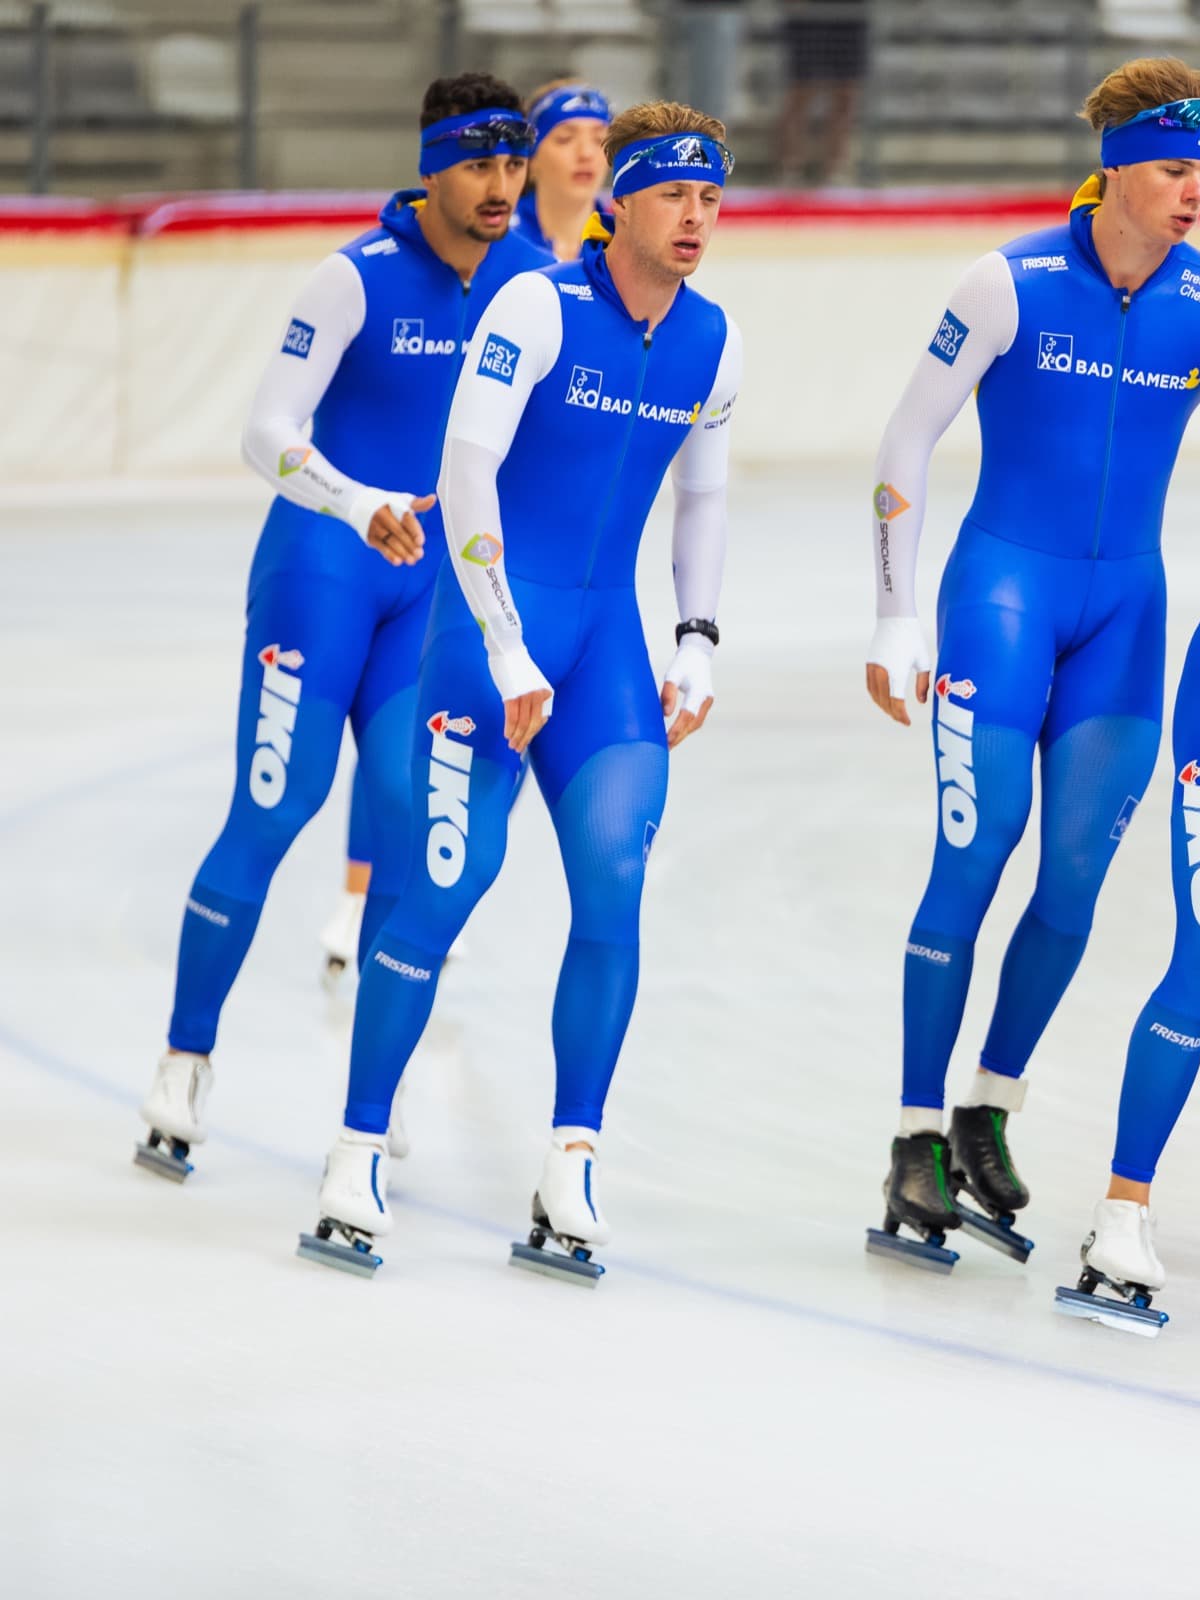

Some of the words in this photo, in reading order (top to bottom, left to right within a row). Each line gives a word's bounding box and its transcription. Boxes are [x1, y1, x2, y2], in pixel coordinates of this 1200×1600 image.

[1022, 255, 1066, 270] FRISTADS
[941, 318, 963, 344] PSY
[425, 340, 456, 355] BAD
[485, 341, 515, 364] PSY
[933, 333, 957, 356] NED
[481, 355, 512, 377] NED
[1076, 359, 1113, 378] BAD
[1122, 368, 1188, 390] KAMERS
[601, 396, 632, 414] BAD
[637, 401, 692, 425] KAMERS
[879, 521, 893, 593] SPECIALIST
[486, 568, 518, 627] SPECIALIST
[374, 950, 432, 981] FRISTADS
